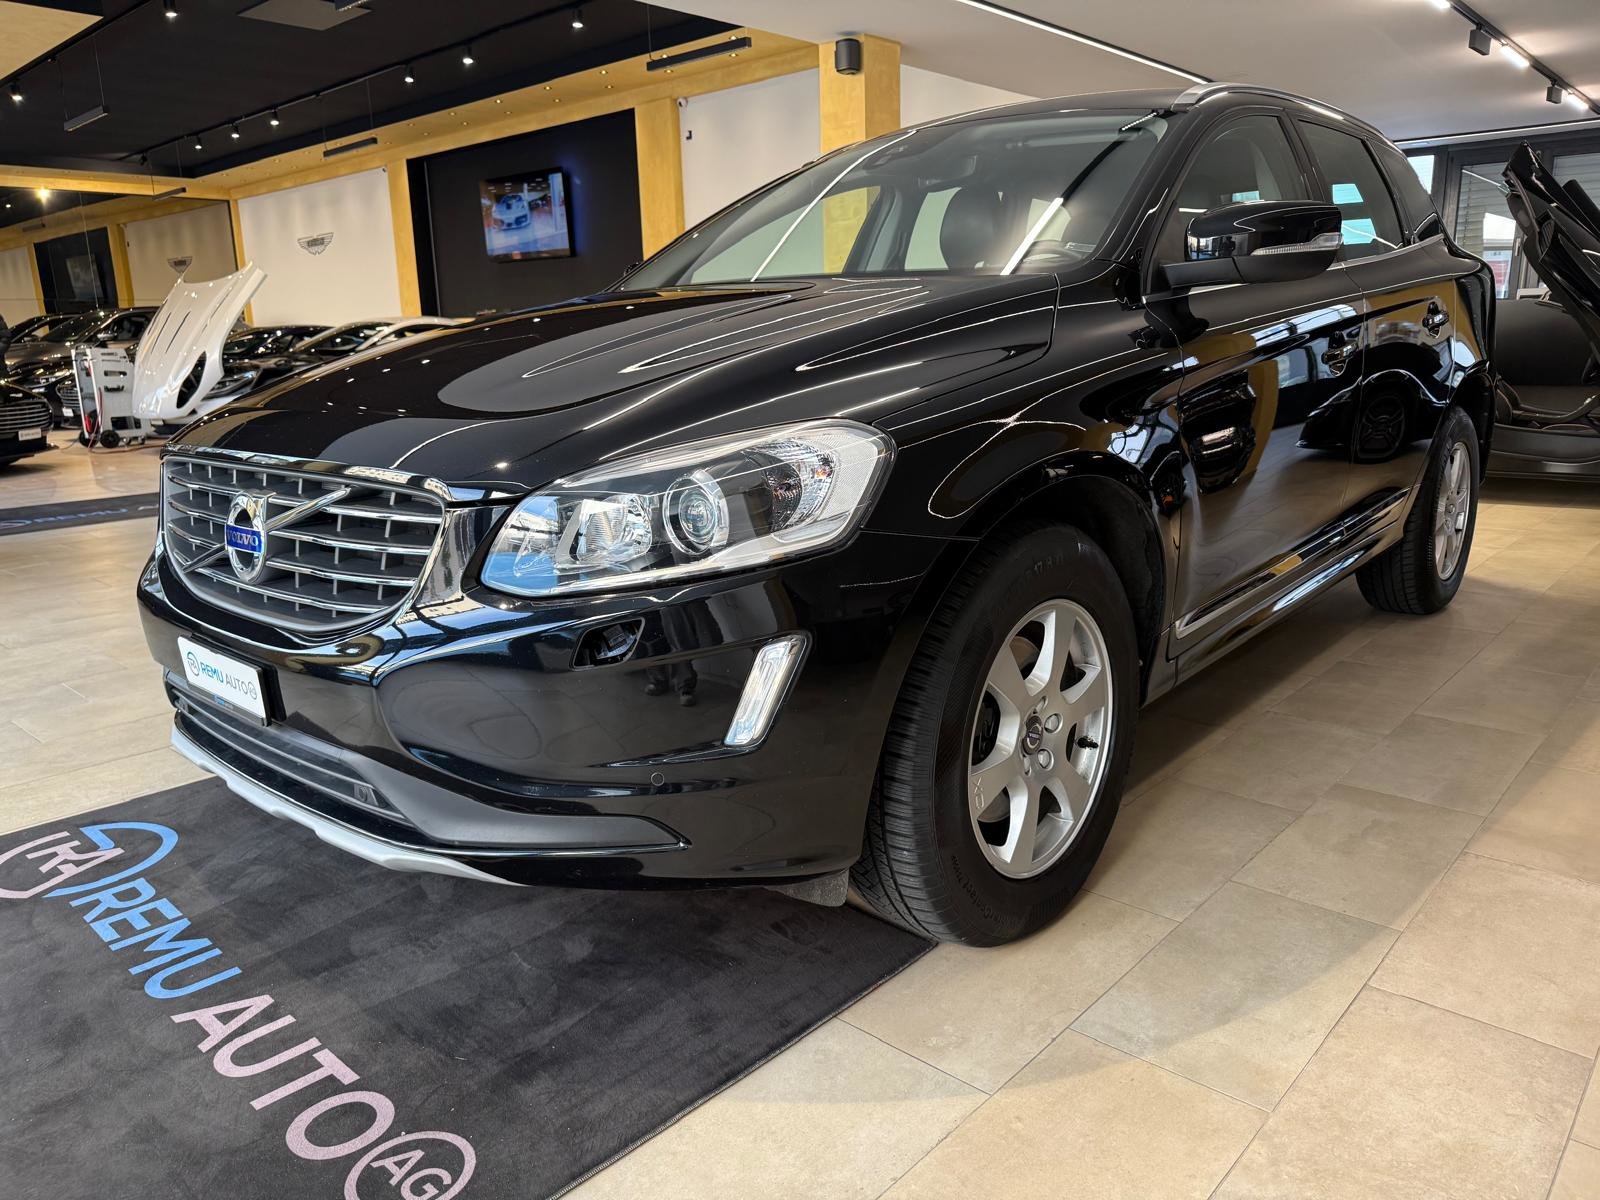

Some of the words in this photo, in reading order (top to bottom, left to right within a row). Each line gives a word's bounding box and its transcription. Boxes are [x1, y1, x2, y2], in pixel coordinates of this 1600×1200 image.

[226, 530, 259, 548] VOLVO
[200, 661, 224, 683] REMU
[225, 673, 248, 695] AUTO
[69, 877, 242, 999] REMU
[171, 994, 395, 1160] AUTO
[369, 1149, 452, 1200] AG
